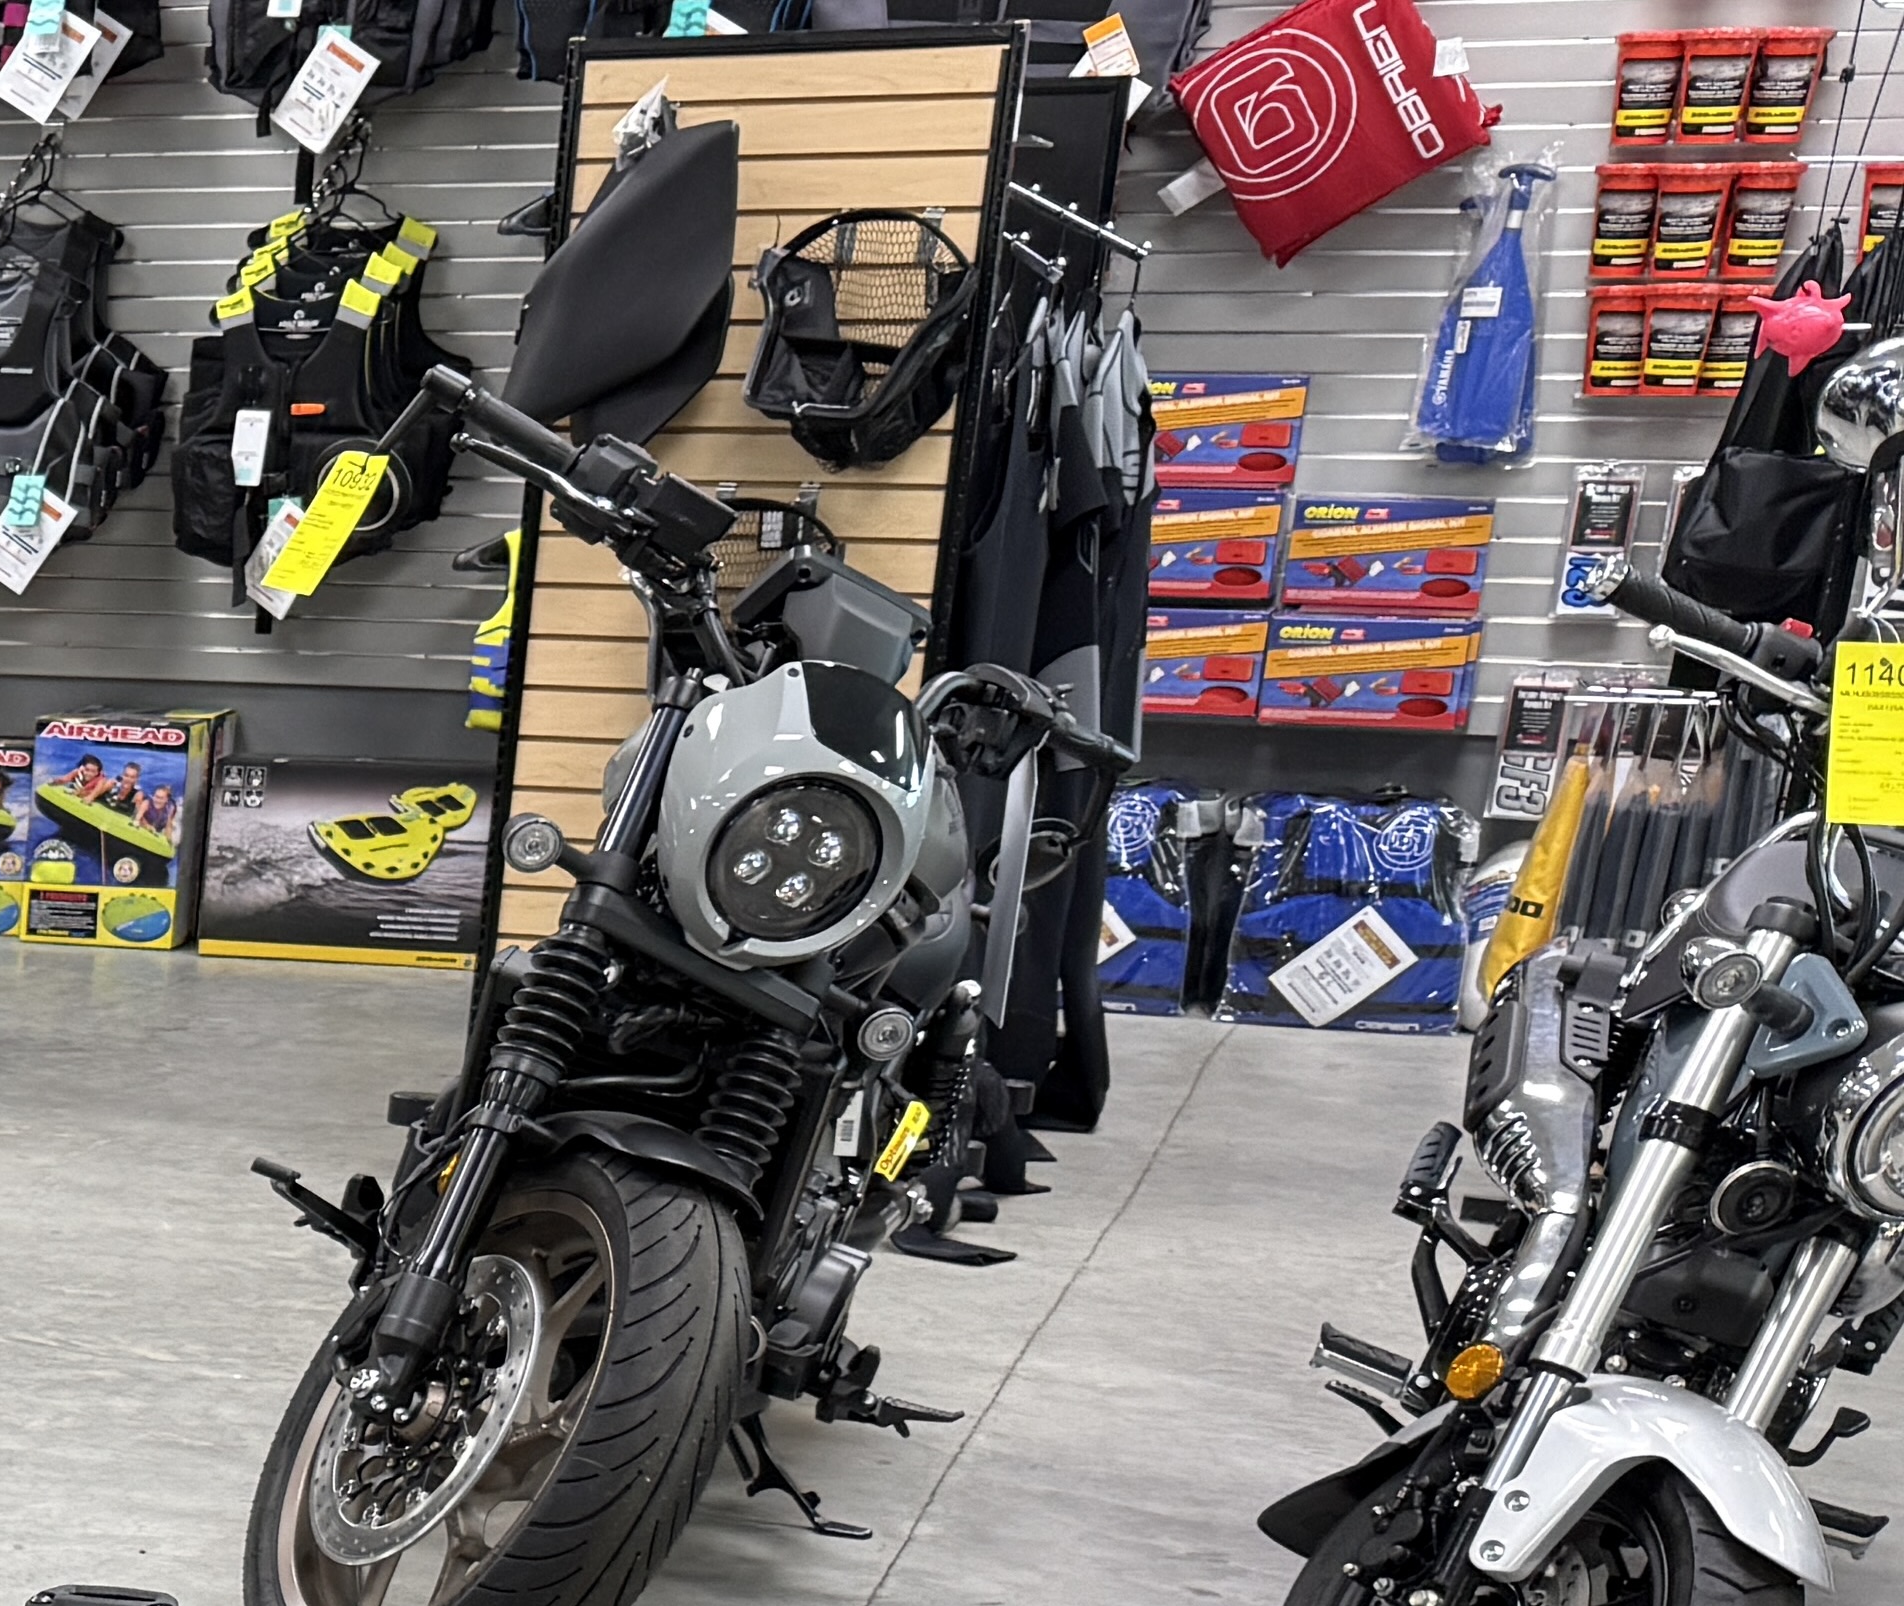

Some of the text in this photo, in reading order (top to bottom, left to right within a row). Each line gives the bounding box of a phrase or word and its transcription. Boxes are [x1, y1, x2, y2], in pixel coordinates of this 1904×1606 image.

[1304, 502, 1360, 521] ORION
[1279, 623, 1336, 641] ORION
[41, 721, 186, 746] AIRHEAD
